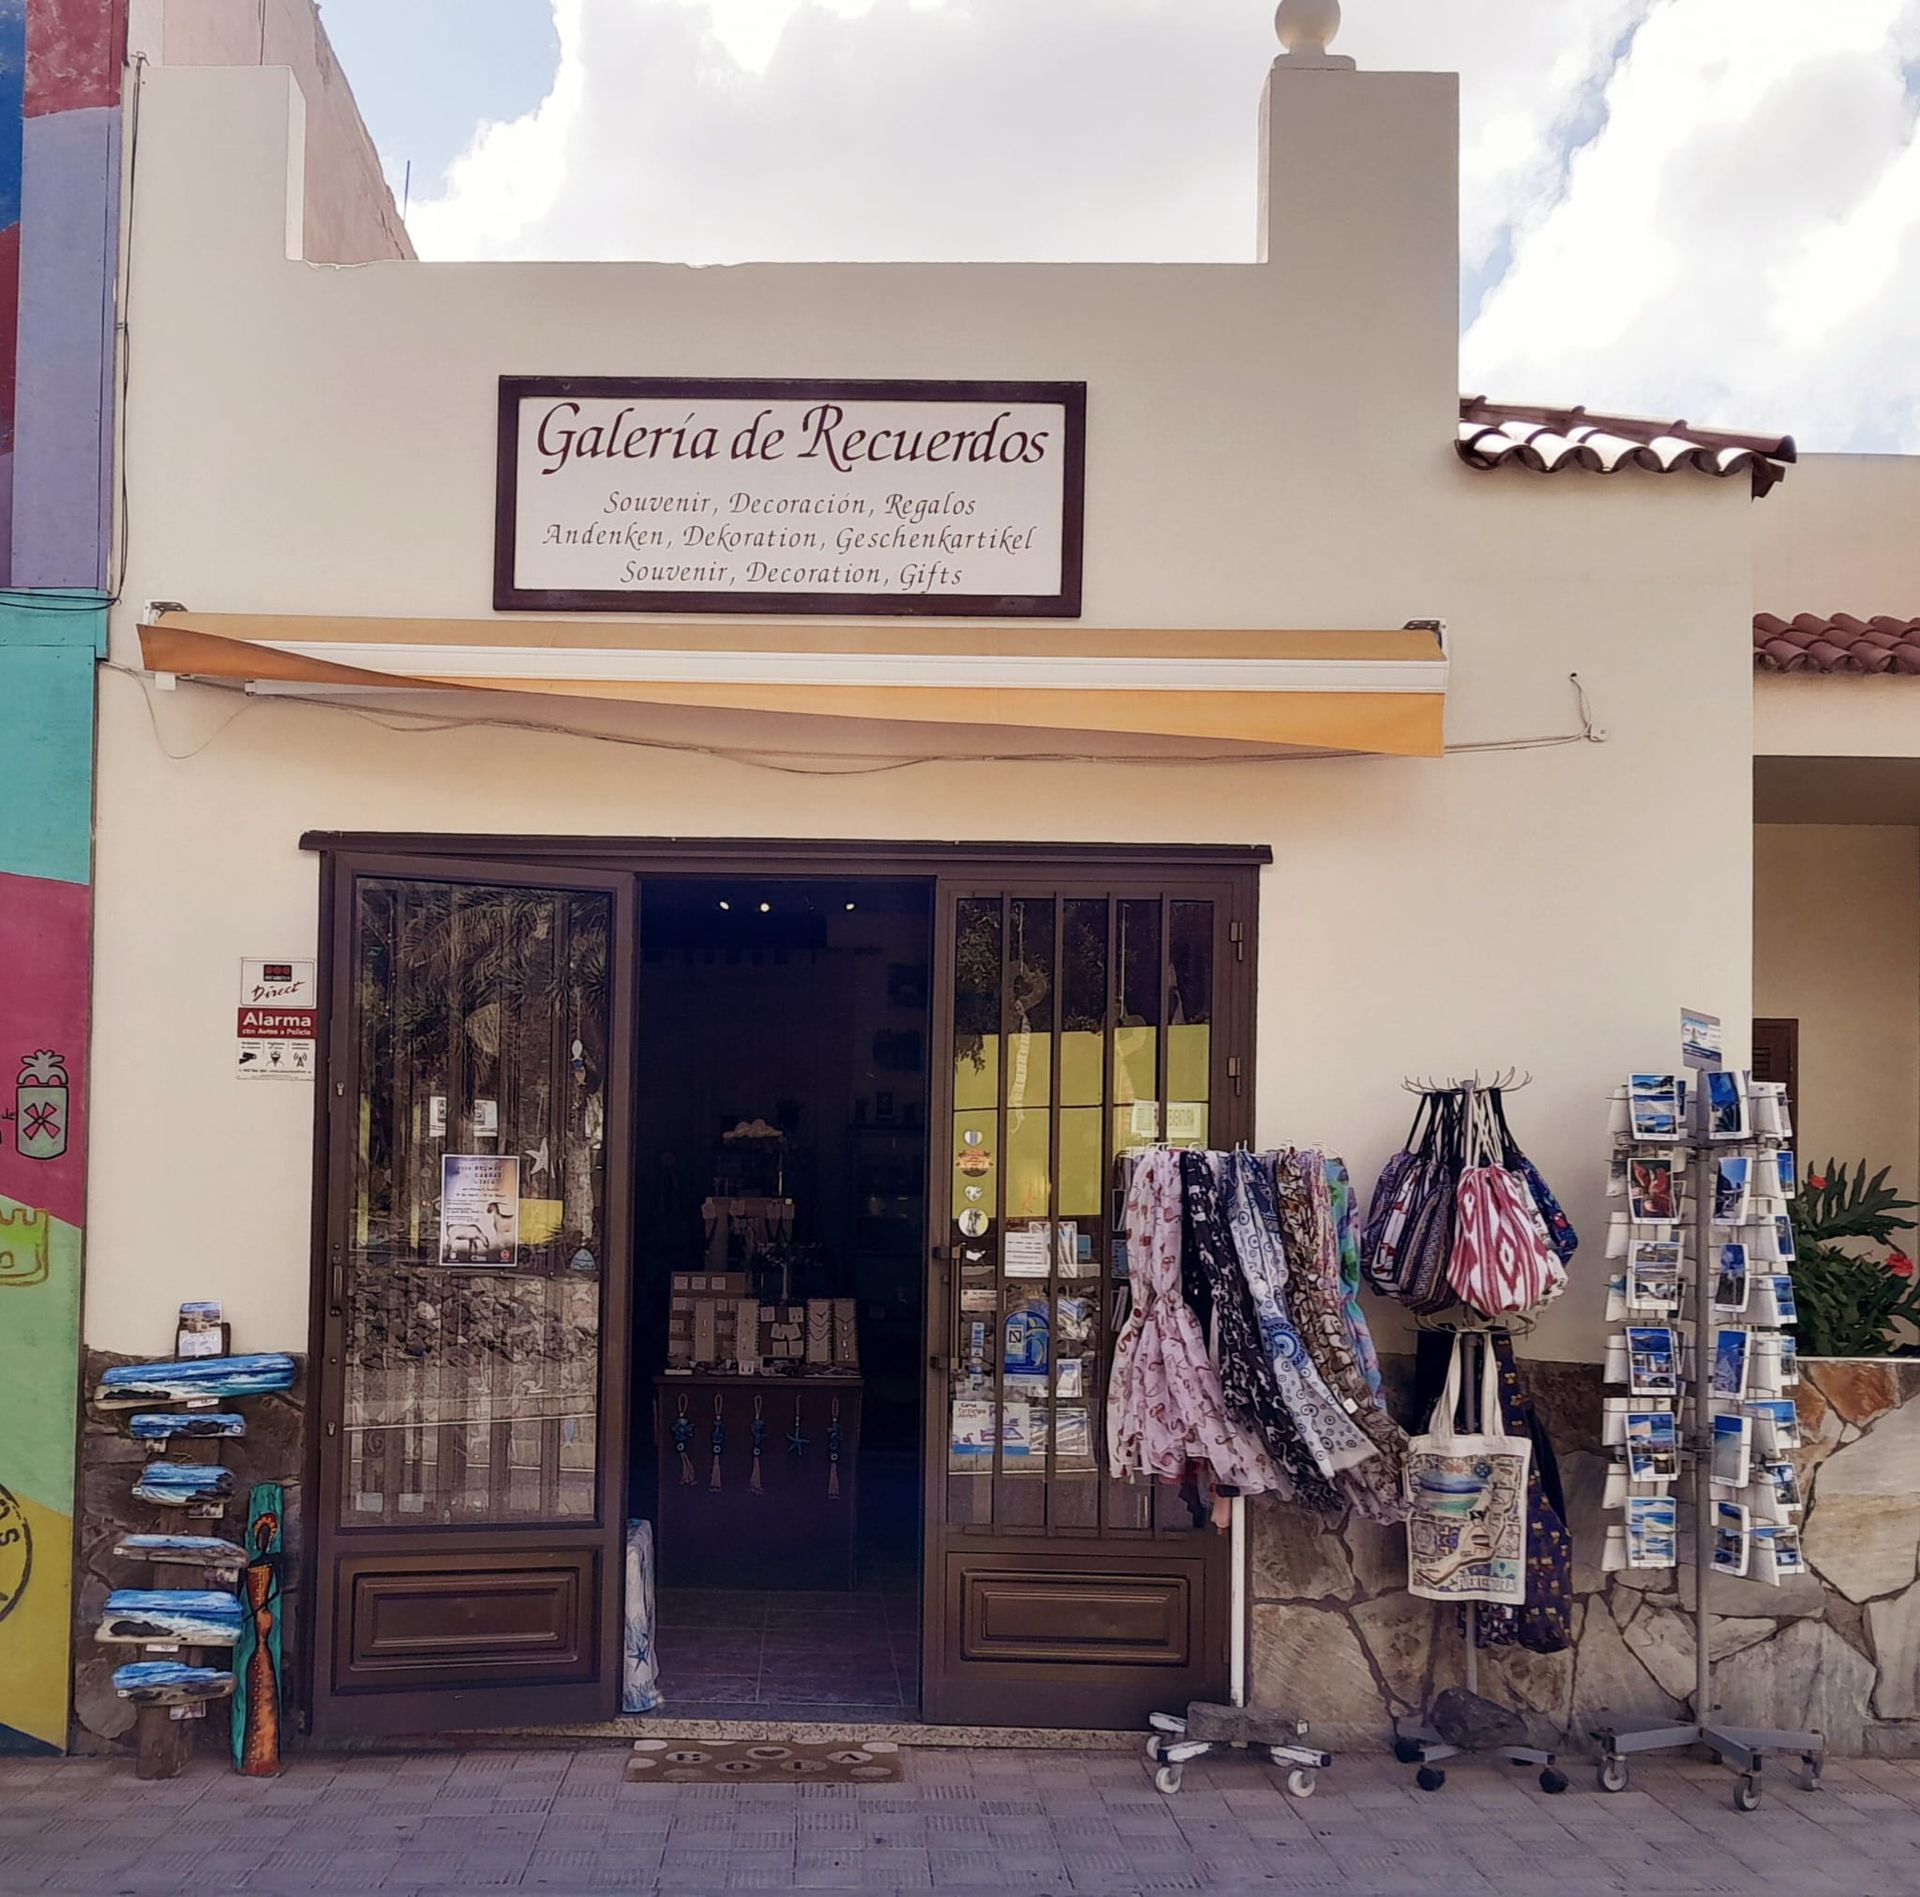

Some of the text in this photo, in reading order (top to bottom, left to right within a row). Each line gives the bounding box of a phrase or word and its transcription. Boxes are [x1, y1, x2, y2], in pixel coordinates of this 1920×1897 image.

[537, 402, 1049, 475] Galería de Recuerdos
[603, 490, 976, 524] Souvenir, Decoración, Regalos
[541, 521, 1037, 556] Andenken, Dekoration, Geschenkartikel
[620, 560, 962, 592] Souvenir, Decoration, Gifts
[252, 981, 306, 1002] Direct
[243, 1011, 312, 1027] Alarma
